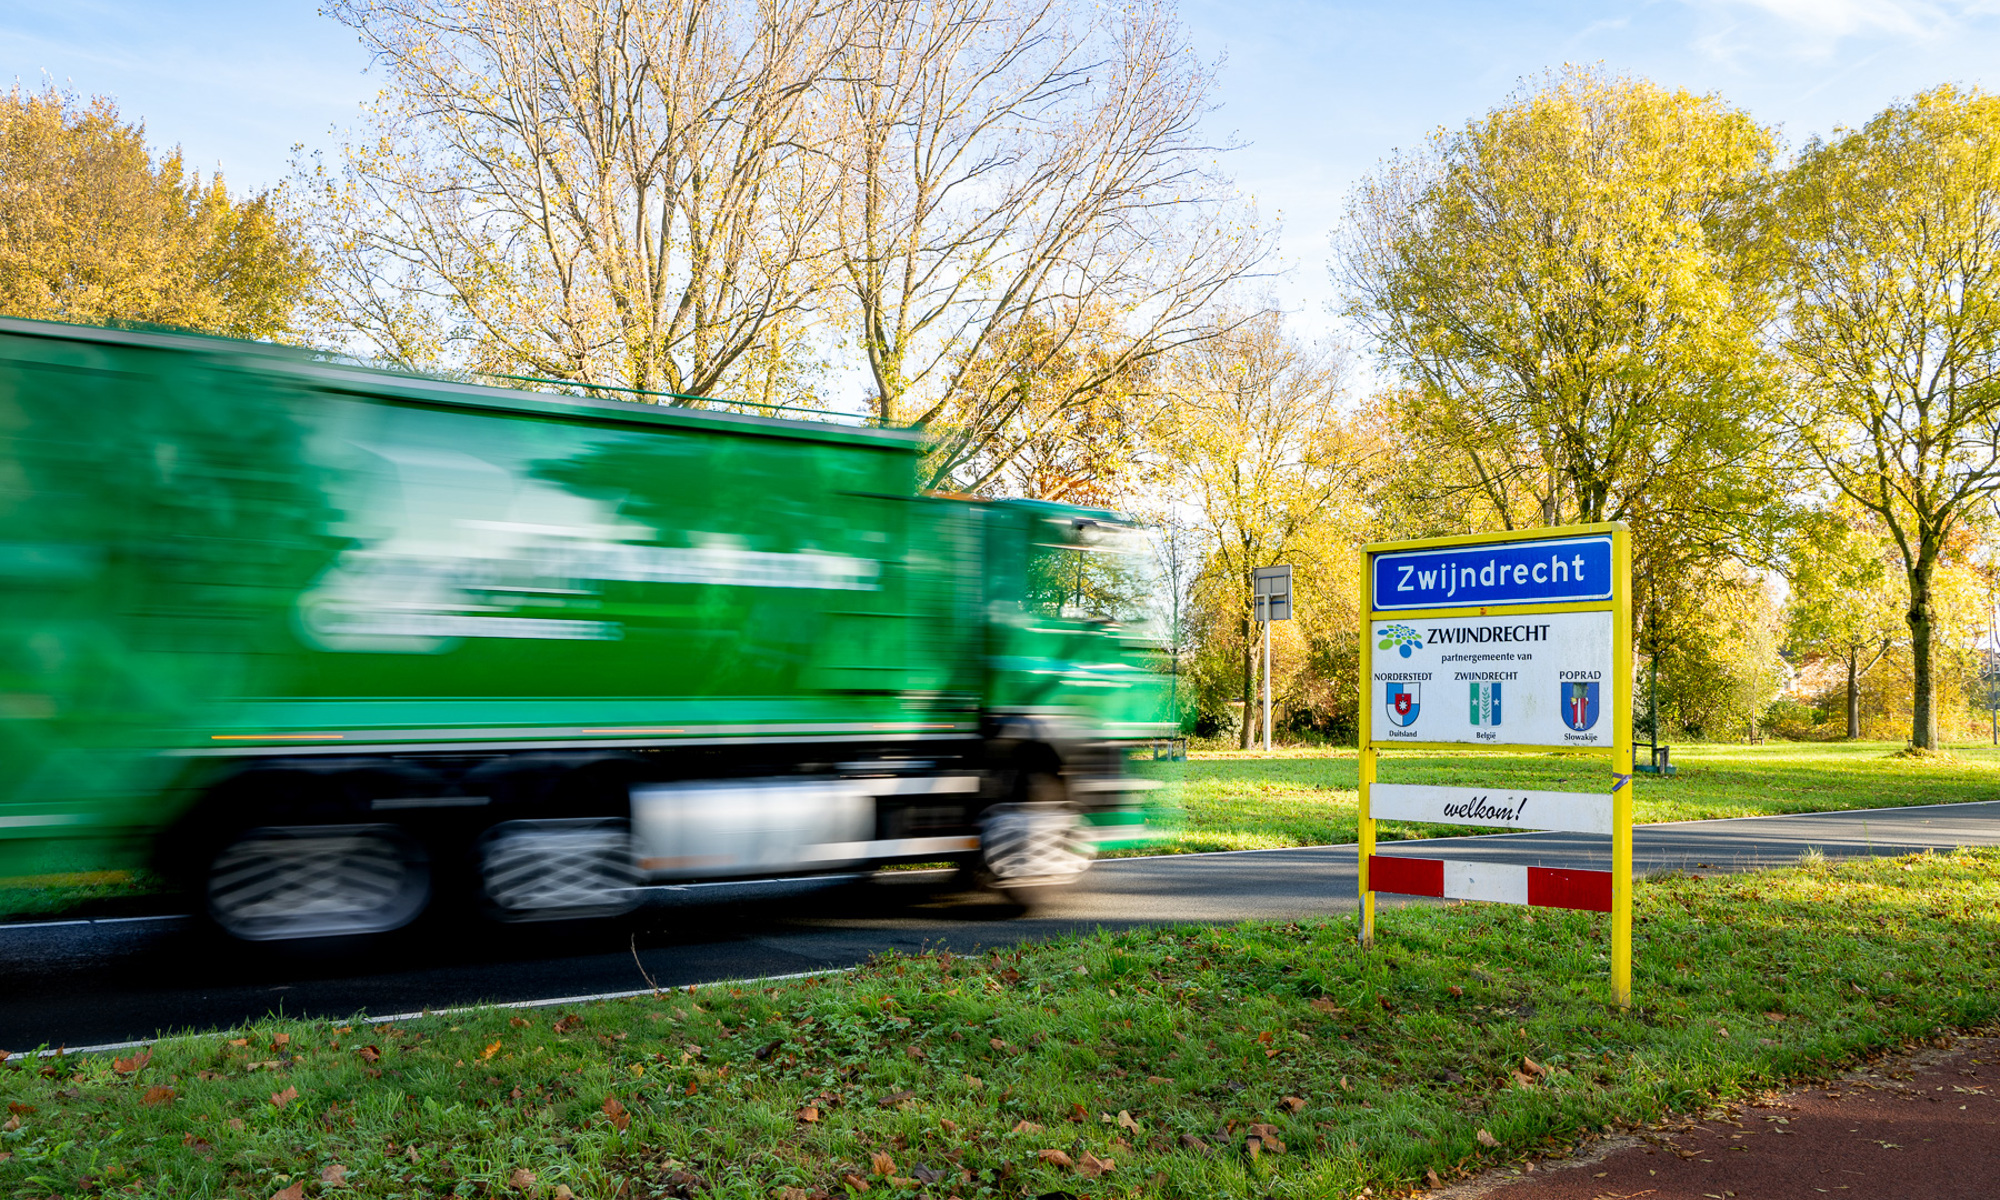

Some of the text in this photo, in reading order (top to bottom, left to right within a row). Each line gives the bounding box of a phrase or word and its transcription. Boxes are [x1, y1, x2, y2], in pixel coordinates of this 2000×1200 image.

[1397, 554, 1585, 598] Zwijndrecht
[1427, 624, 1550, 644] ZWIJNDRECHT
[1441, 652, 1532, 663] partnergemeente van
[1374, 672, 1433, 681] NORDERSTEDT
[1454, 671, 1518, 681] ZWIJNDRECHT
[1559, 670, 1601, 680] POPRAD
[1389, 730, 1418, 738] Duitsland
[1476, 731, 1496, 740] België
[1564, 733, 1598, 742] Slowakije
[1443, 796, 1527, 821] welkom!
